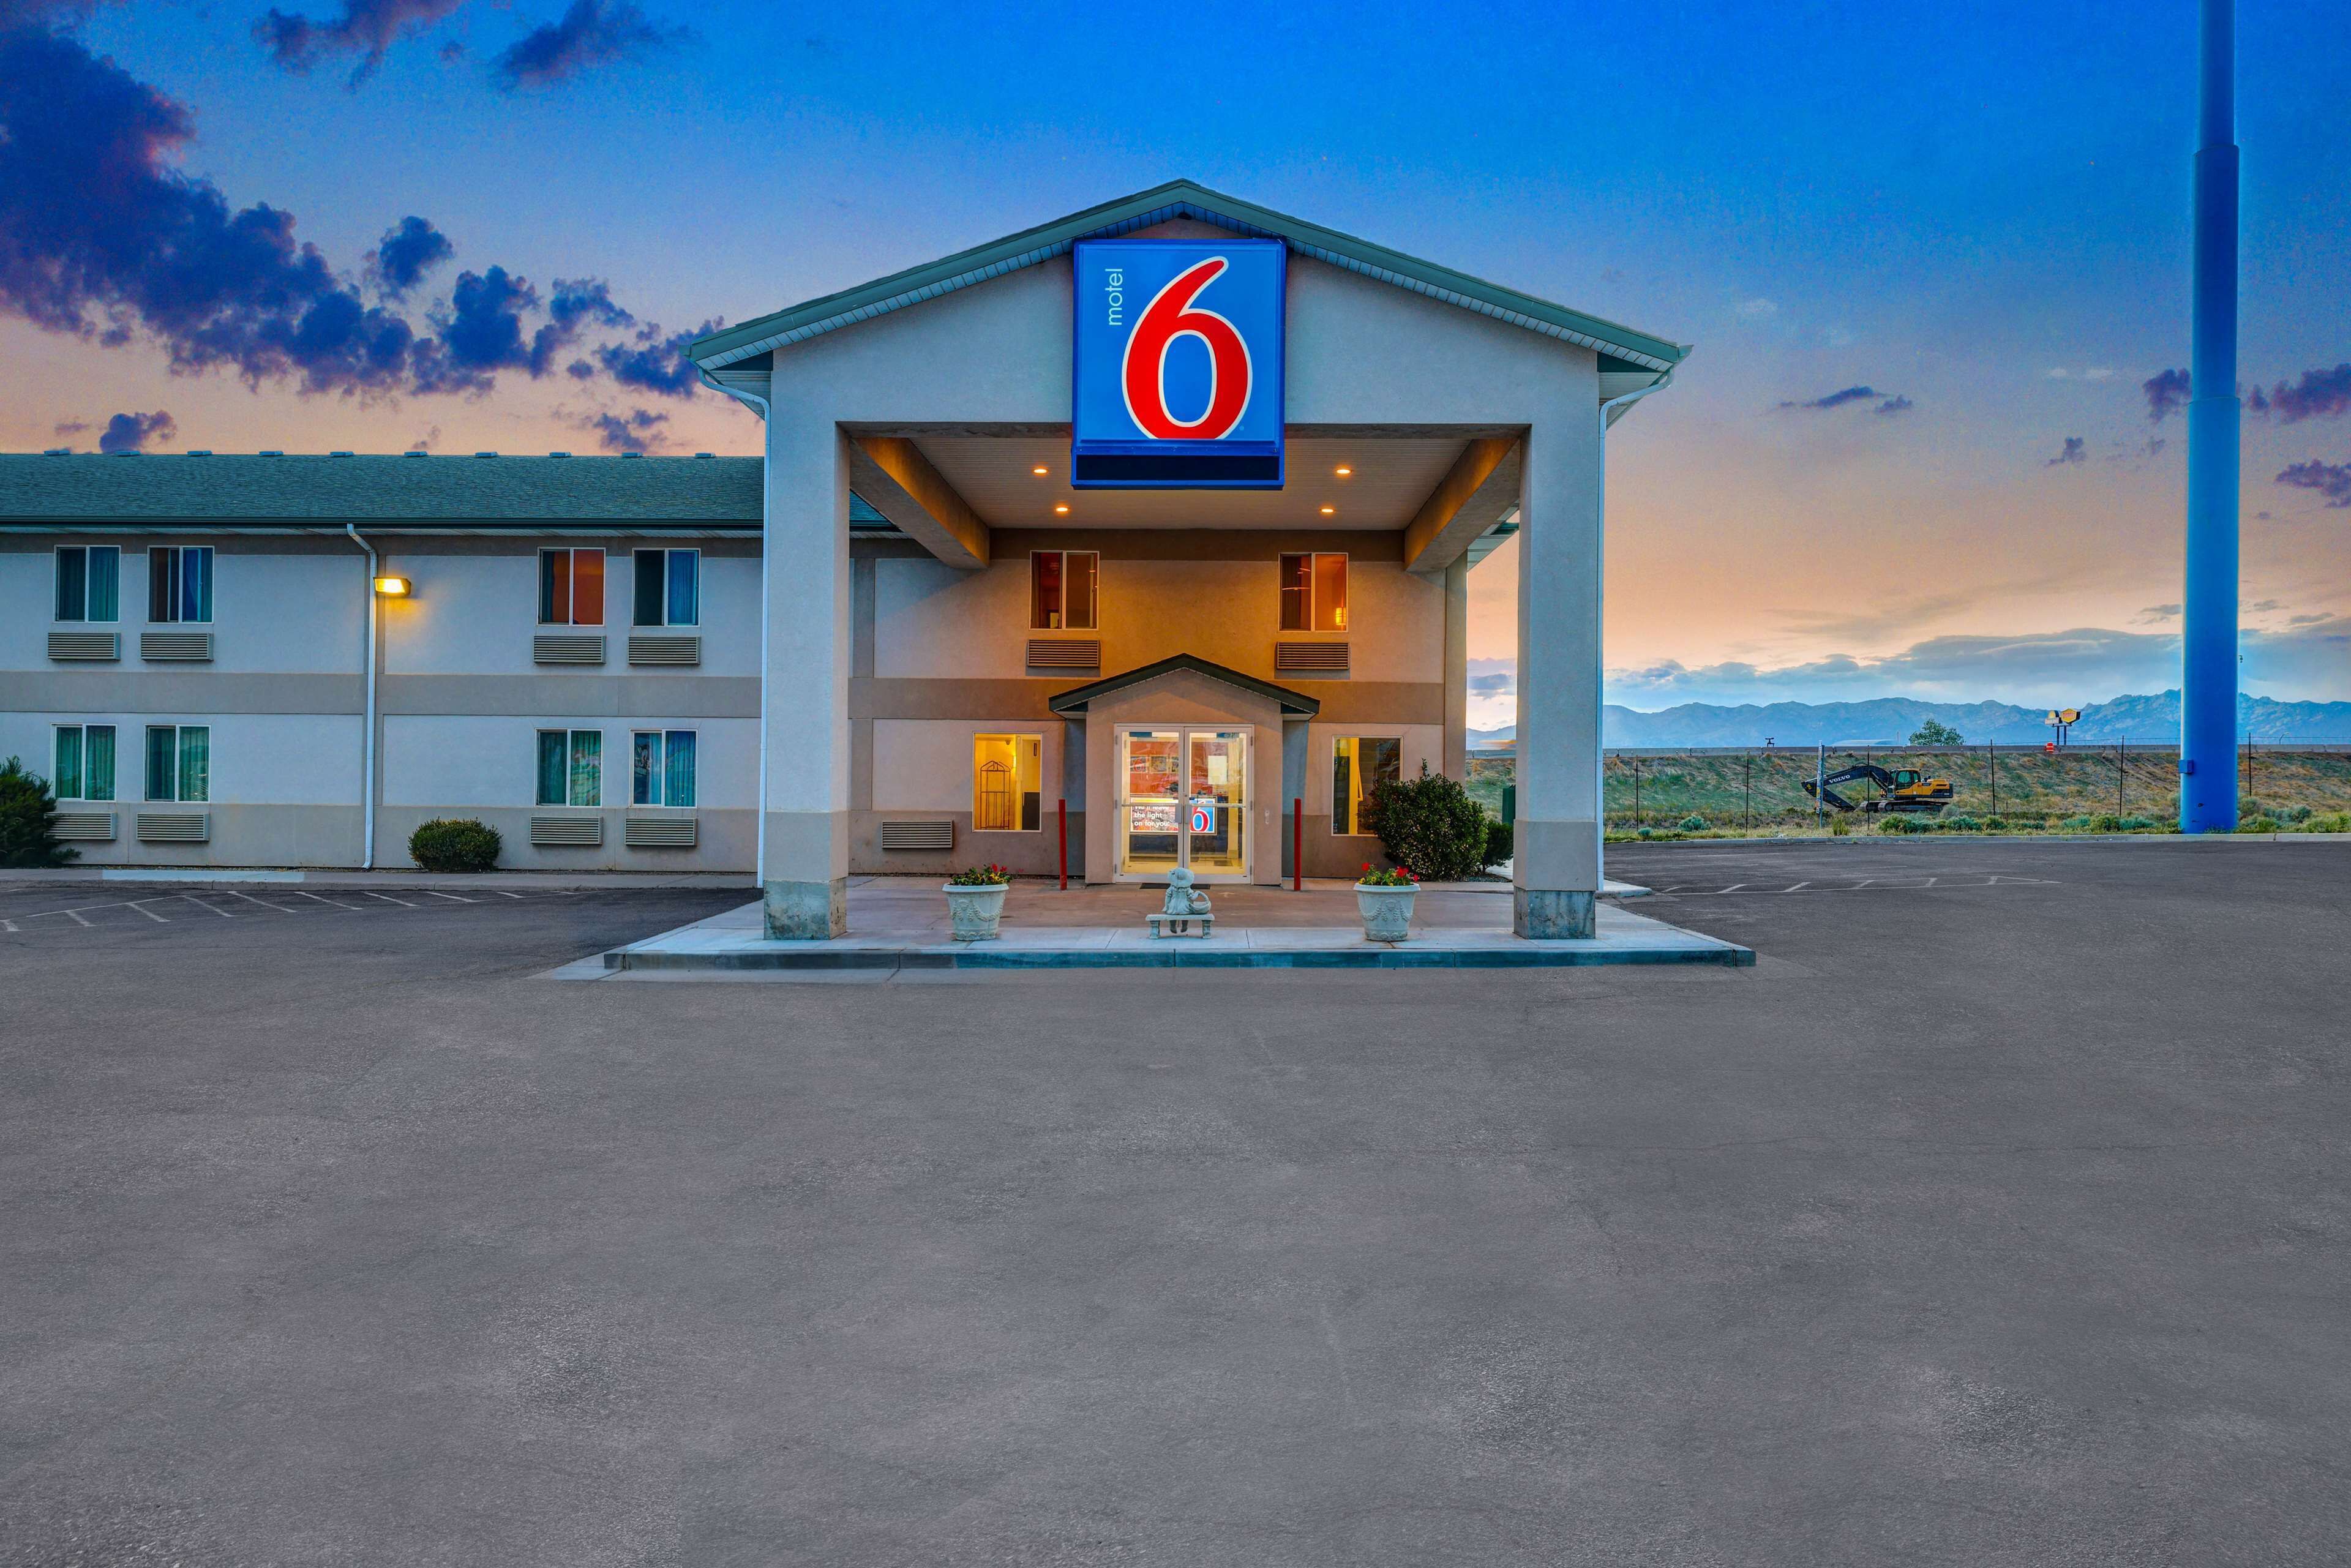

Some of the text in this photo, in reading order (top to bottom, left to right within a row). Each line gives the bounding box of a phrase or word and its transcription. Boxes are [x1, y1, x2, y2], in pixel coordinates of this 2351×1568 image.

[1104, 255, 1253, 440] motel 6
[1829, 775, 1850, 783] VOLVO
